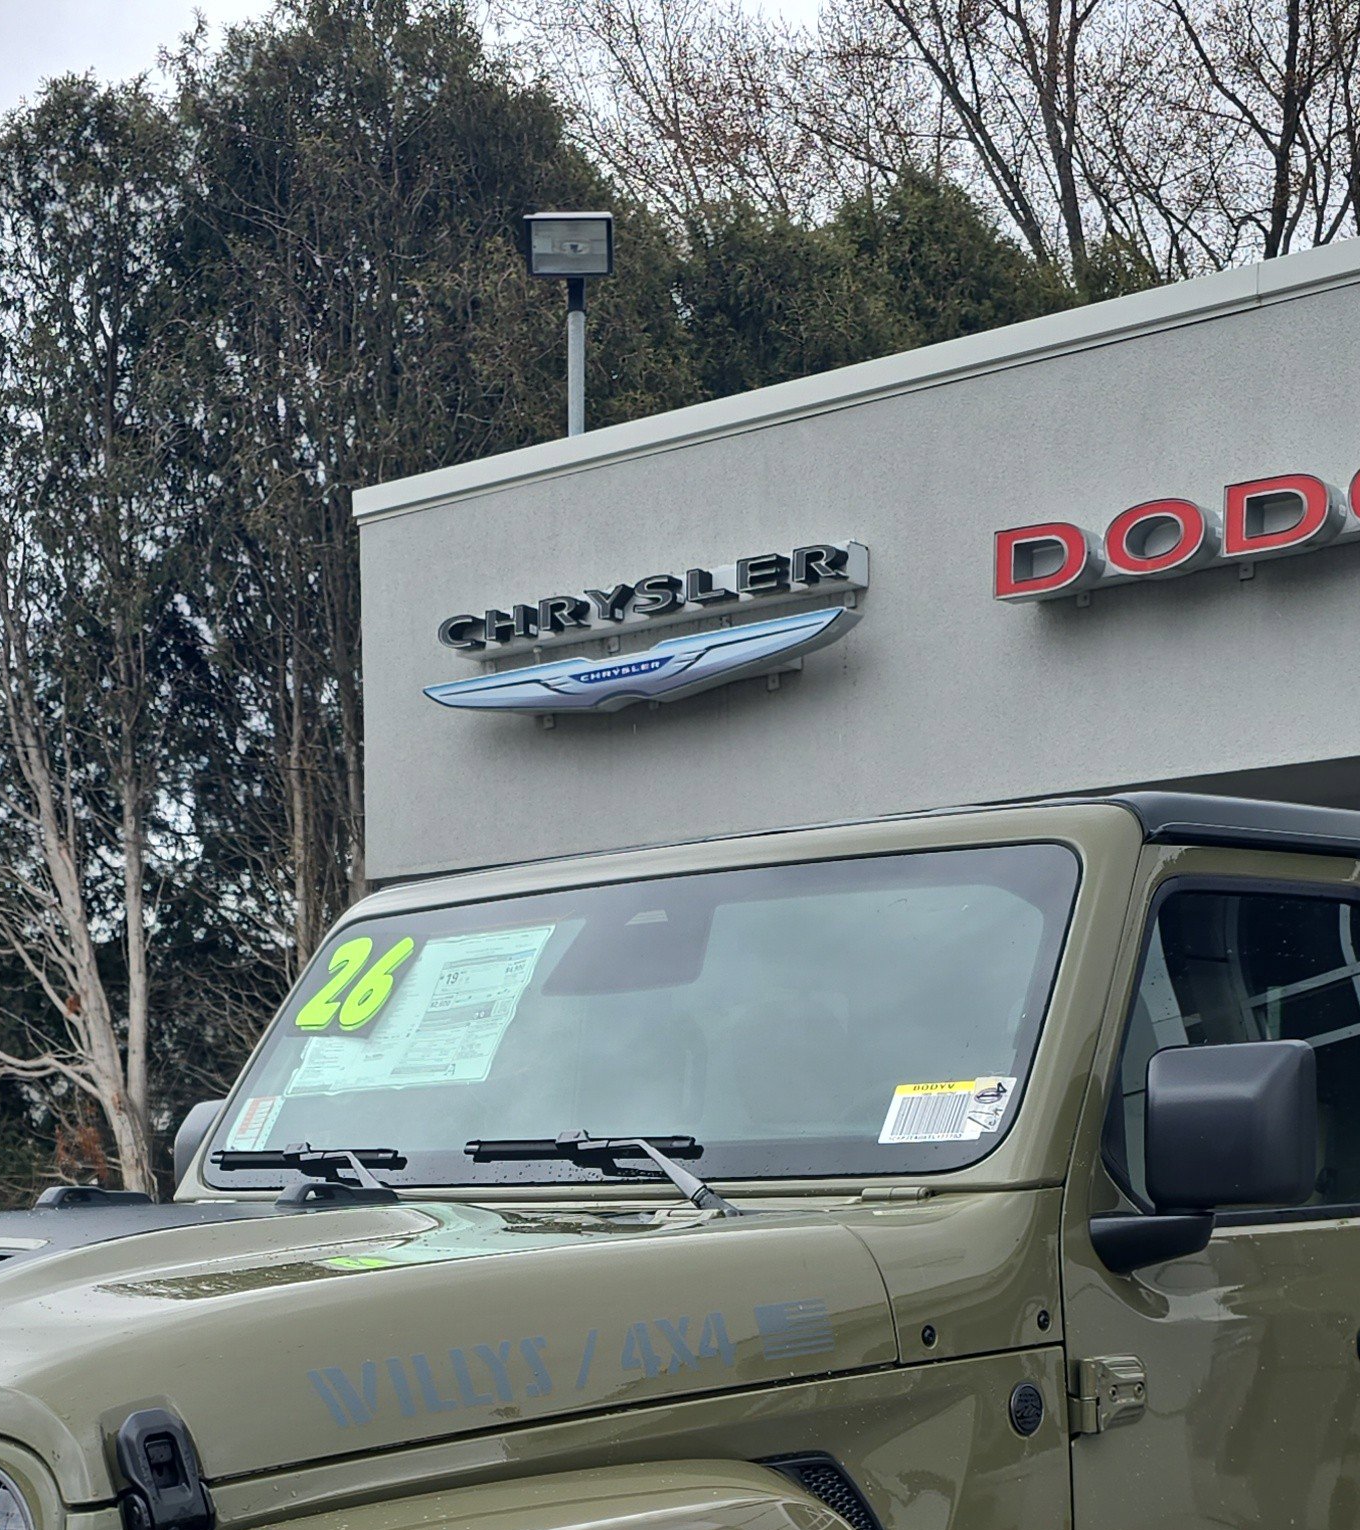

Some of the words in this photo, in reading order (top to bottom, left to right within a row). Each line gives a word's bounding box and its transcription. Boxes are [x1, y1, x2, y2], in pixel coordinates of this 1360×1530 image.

[437, 543, 850, 650] CHRYSLER
[579, 660, 661, 682] CHRYSLER
[295, 936, 415, 1032] 26
[306, 1336, 553, 1429] WILLYS
[620, 1311, 738, 1379] 4X4
